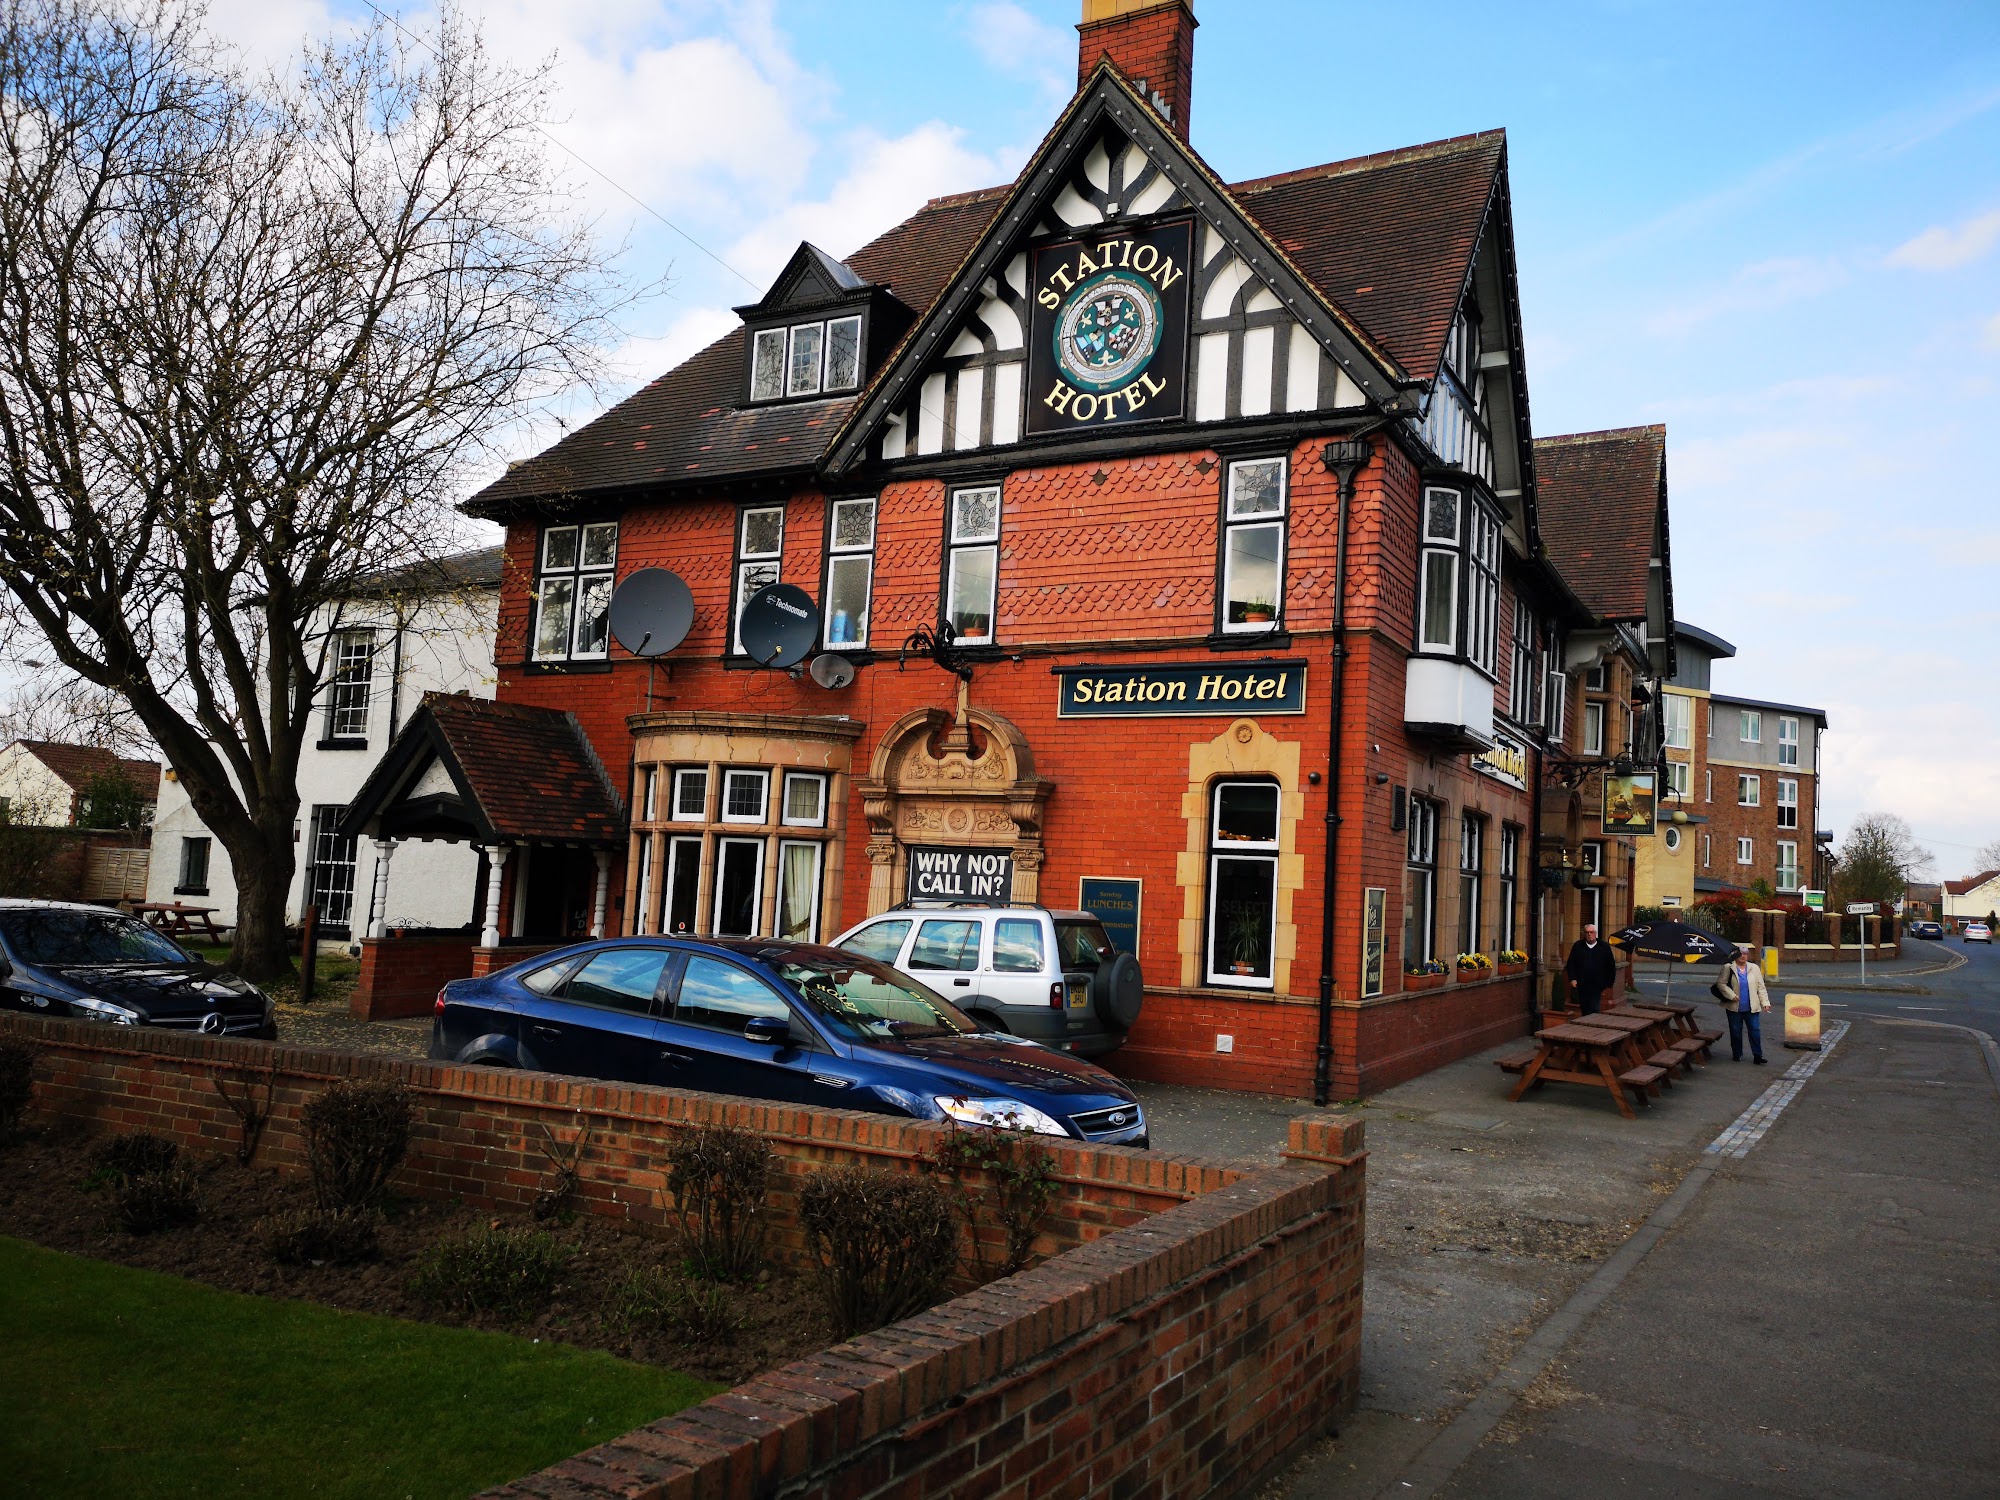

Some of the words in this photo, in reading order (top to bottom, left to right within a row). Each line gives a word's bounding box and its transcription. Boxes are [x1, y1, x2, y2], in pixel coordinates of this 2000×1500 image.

[1038, 240, 1184, 310] STATION
[1044, 371, 1167, 421] HOTEL
[776, 598, 808, 619] Technomate
[1073, 675, 1187, 703] Station
[1195, 672, 1288, 701] Hotel
[917, 853, 962, 873] WHY
[967, 855, 1009, 876] NOT
[917, 872, 964, 895] CALL
[971, 875, 1004, 896] IN?
[1099, 891, 1123, 899] Sunday
[1087, 899, 1134, 910] LUNCHES
